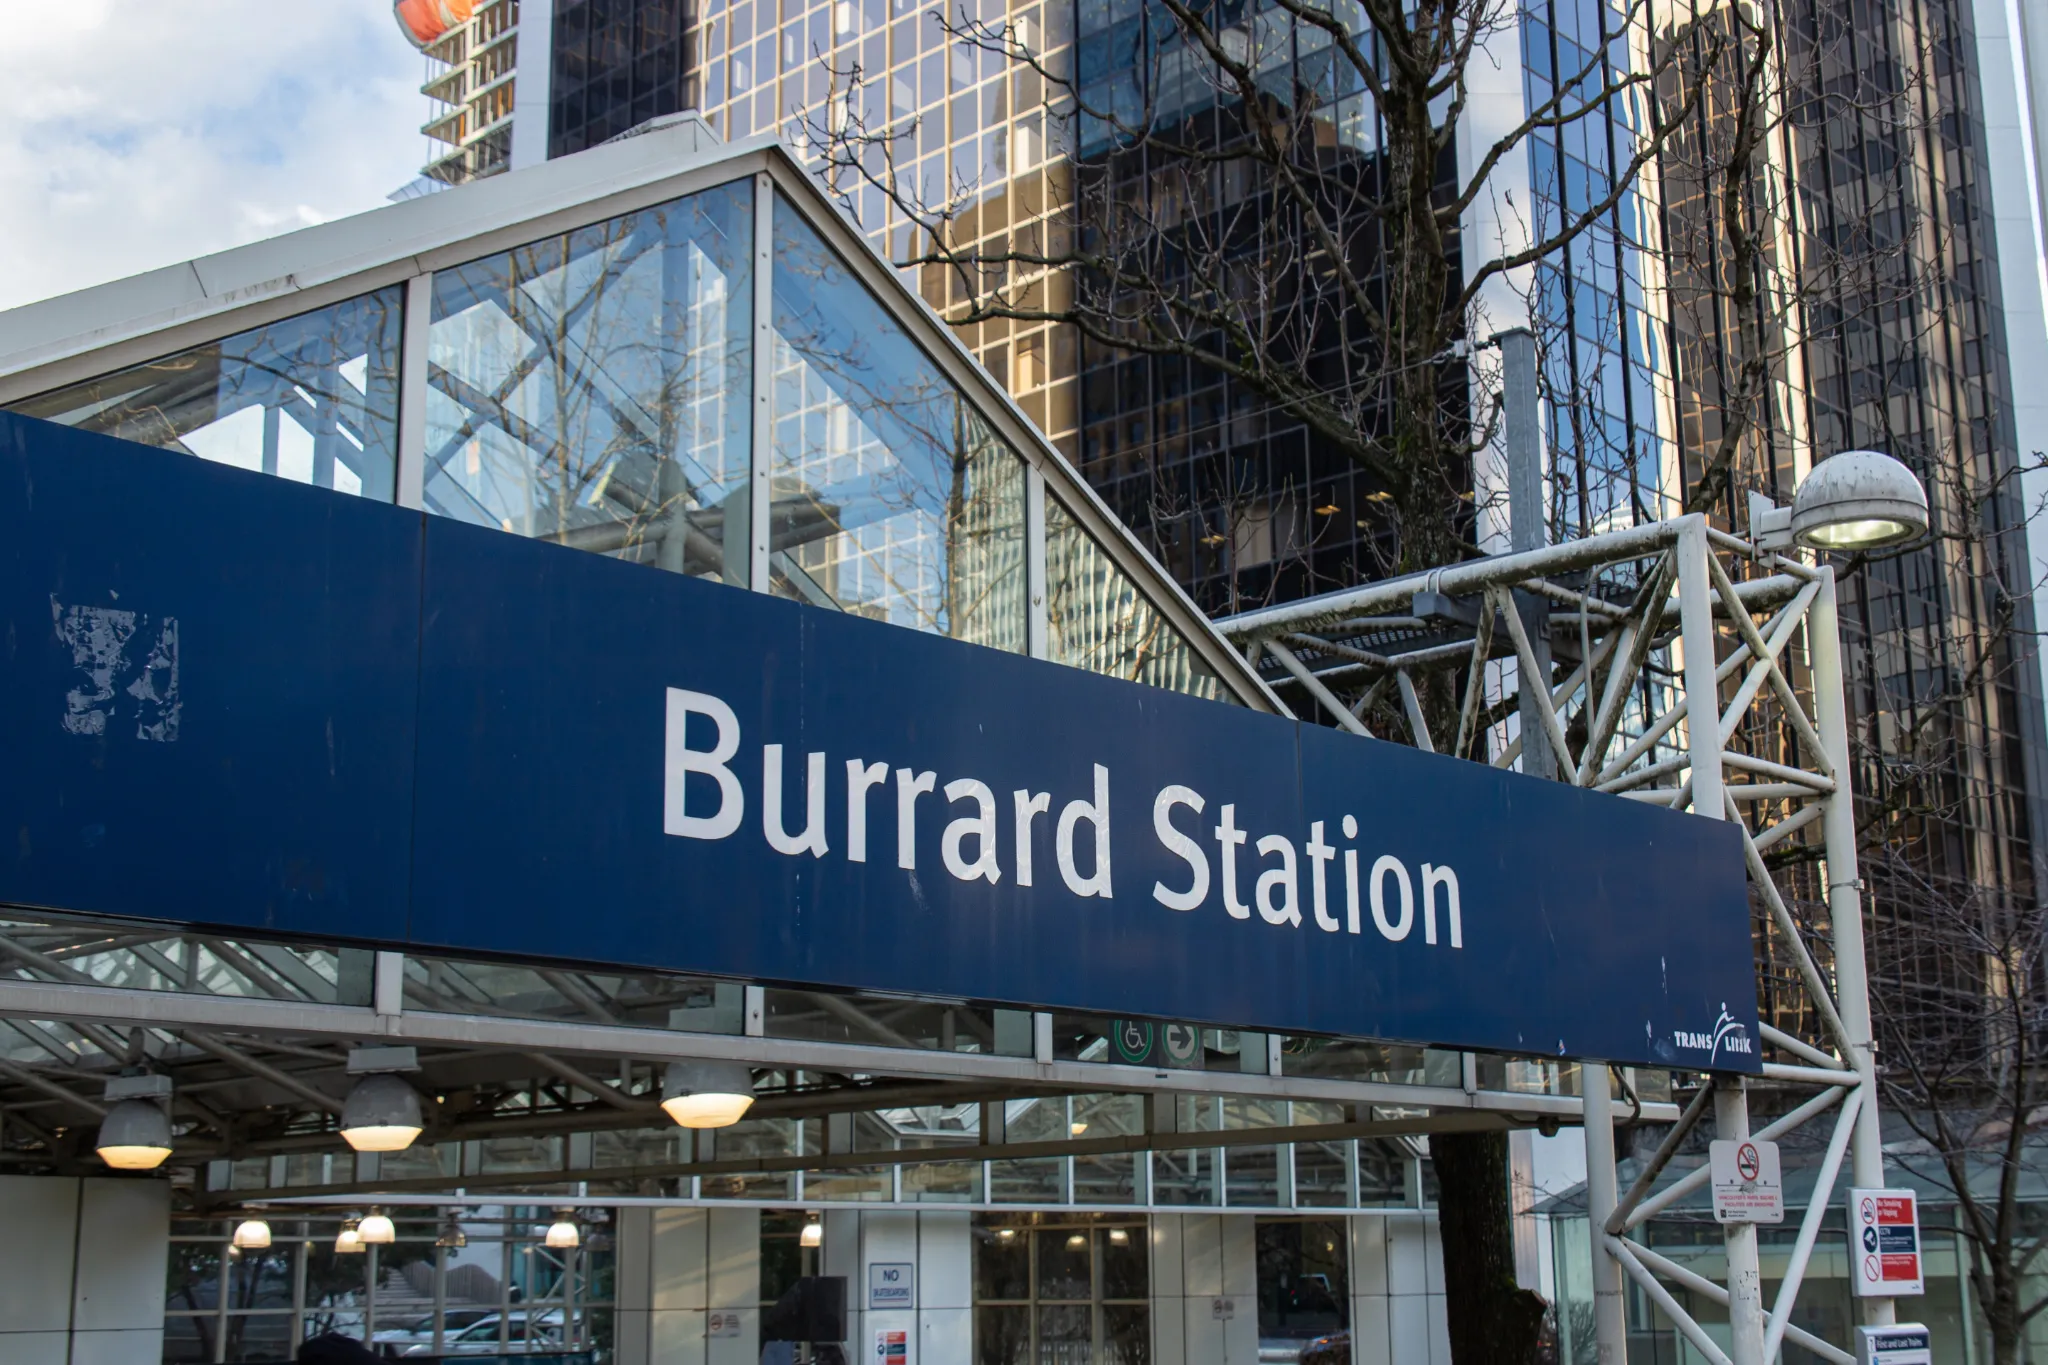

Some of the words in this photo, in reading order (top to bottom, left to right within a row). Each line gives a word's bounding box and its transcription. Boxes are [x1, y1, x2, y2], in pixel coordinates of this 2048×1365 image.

[664, 687, 1113, 899] Burrard
[1152, 784, 1463, 950] Station
[1674, 1031, 1713, 1050] TRANS
[883, 1269, 899, 1281] NO
